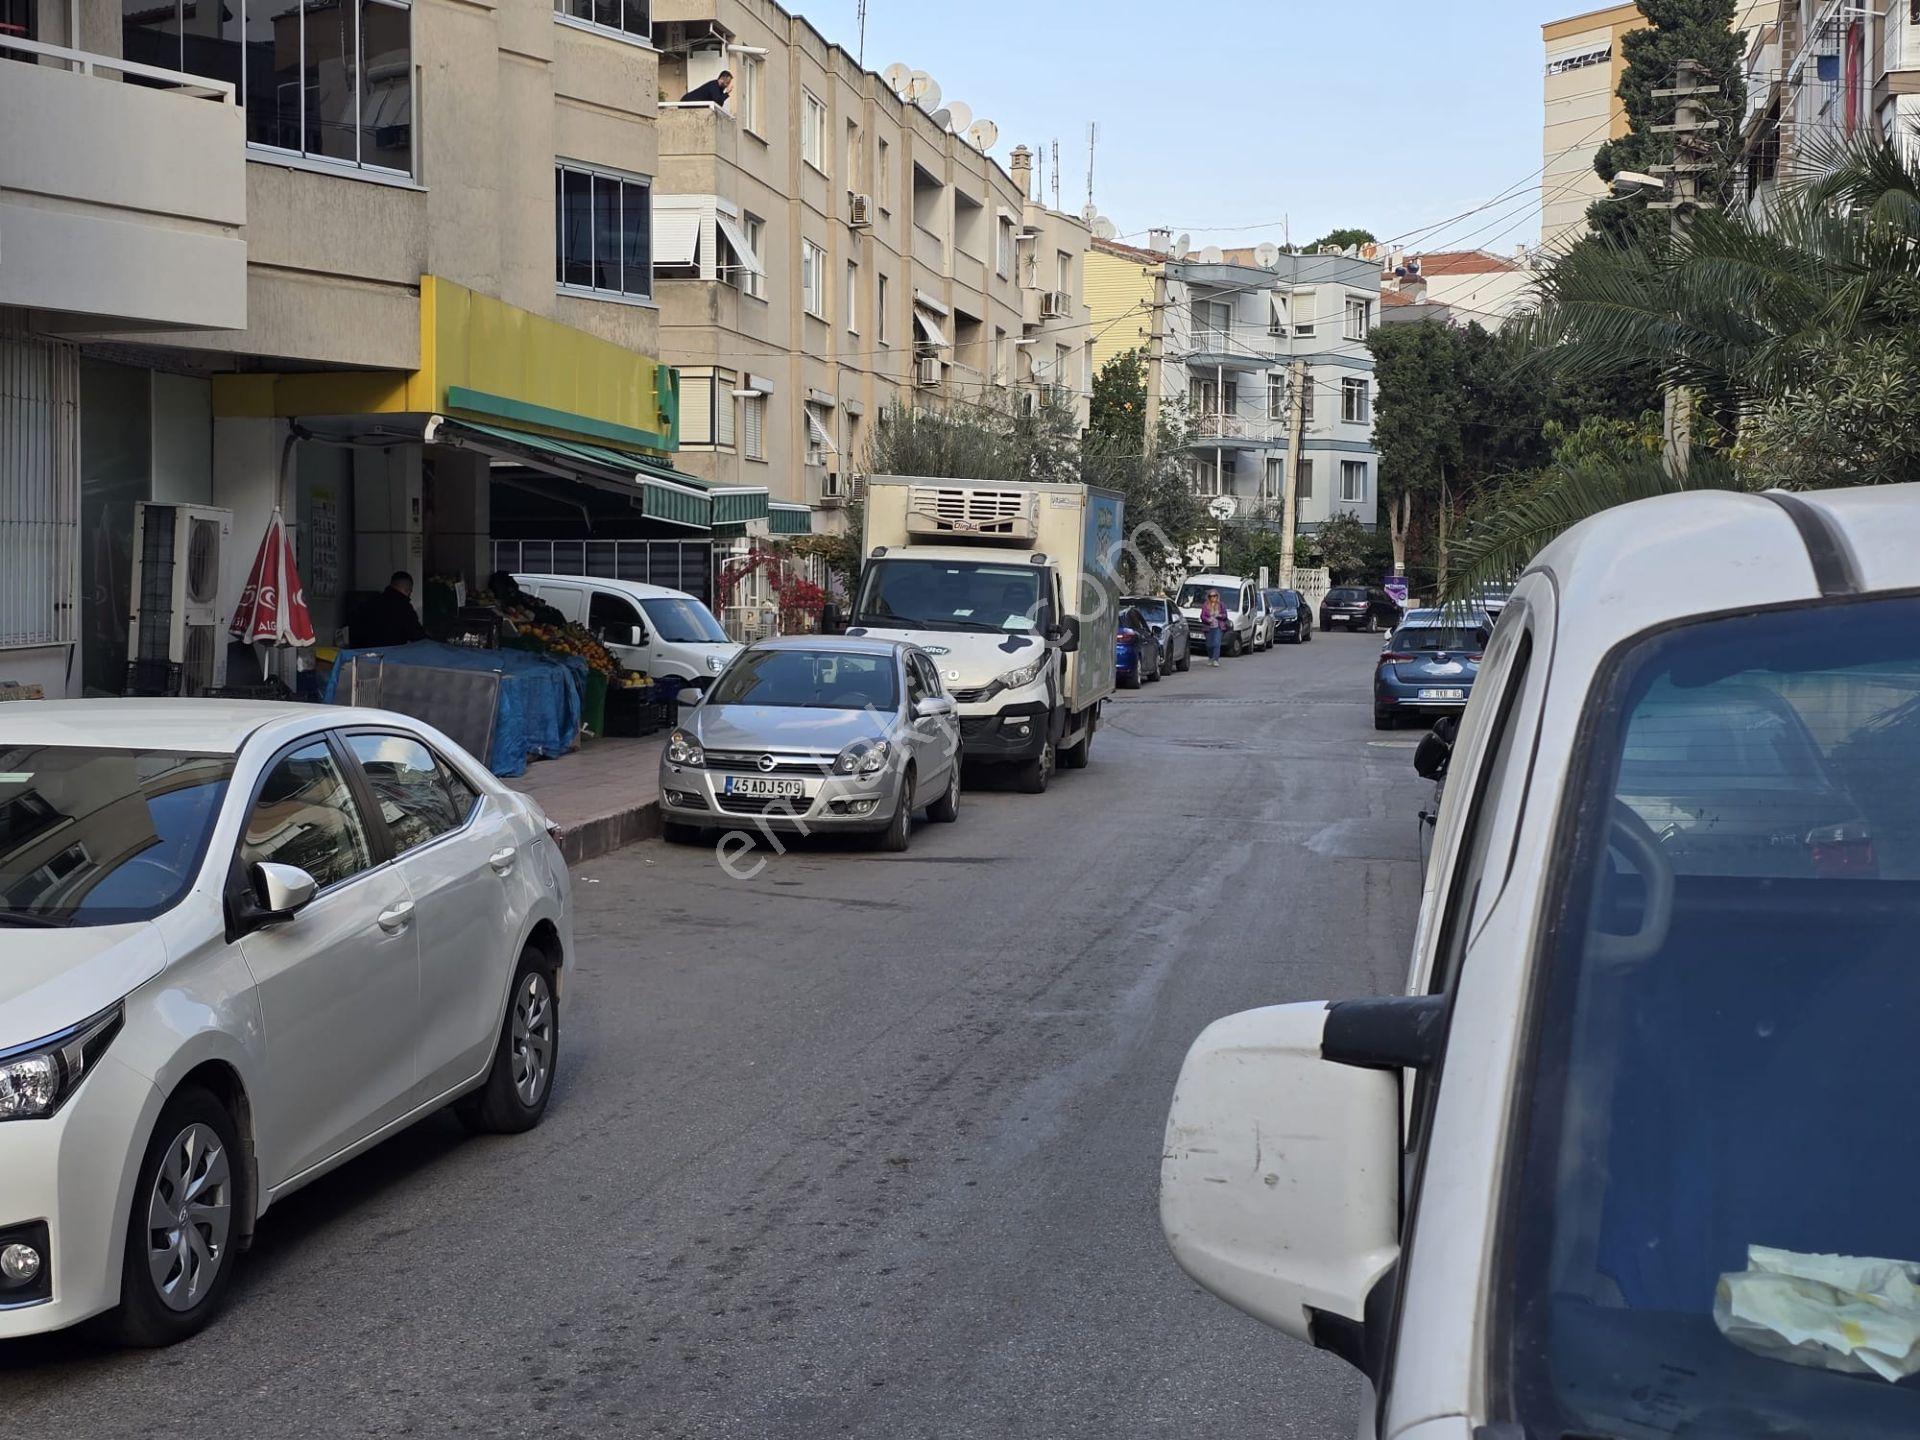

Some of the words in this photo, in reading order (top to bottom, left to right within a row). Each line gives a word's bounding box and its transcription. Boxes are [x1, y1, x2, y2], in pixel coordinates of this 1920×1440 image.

[733, 779, 749, 792] 45
[751, 780, 775, 793] ADJ
[777, 781, 801, 795] 509
